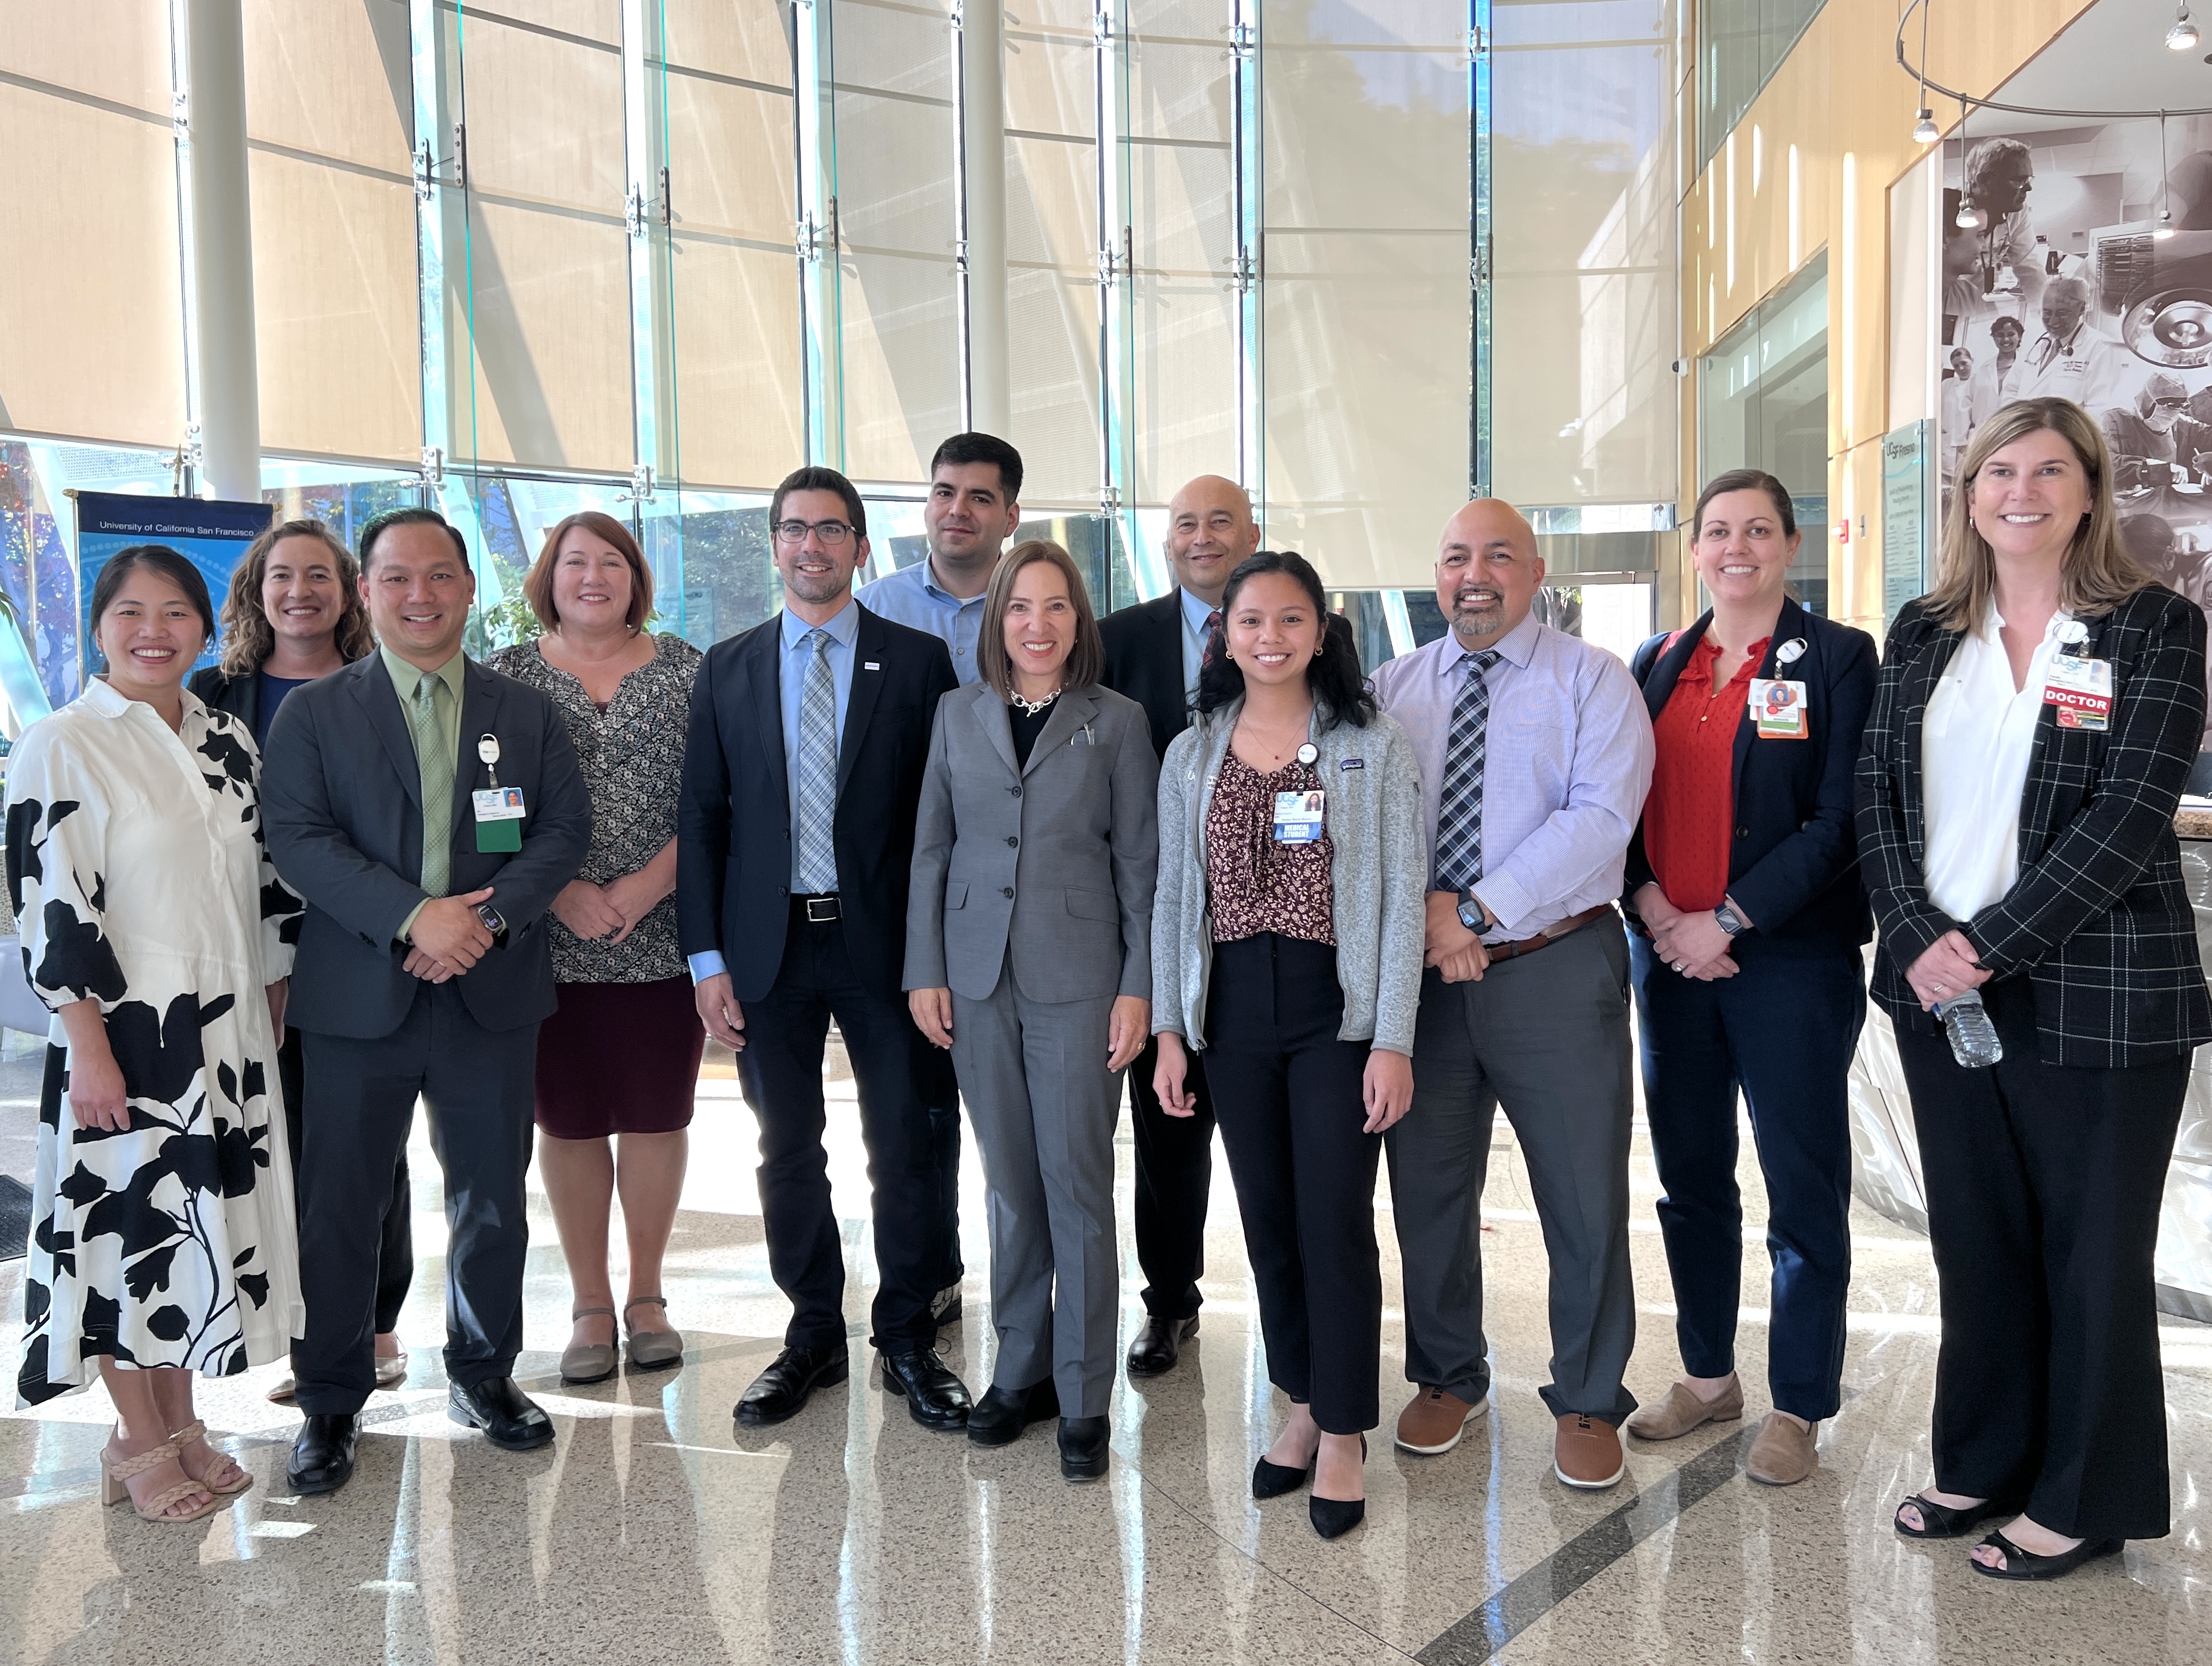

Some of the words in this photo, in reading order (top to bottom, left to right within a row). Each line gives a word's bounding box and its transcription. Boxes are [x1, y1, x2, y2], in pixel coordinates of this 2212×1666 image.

[1886, 442, 1898, 459] UCSF
[100, 521, 142, 532] University
[156, 524, 194, 533] California
[215, 527, 254, 537] Francisco
[2052, 654, 2083, 671] UCSF
[2046, 690, 2107, 710] DOCTOR
[474, 792, 498, 804] UCSF
[1277, 793, 1299, 806] UCSF
